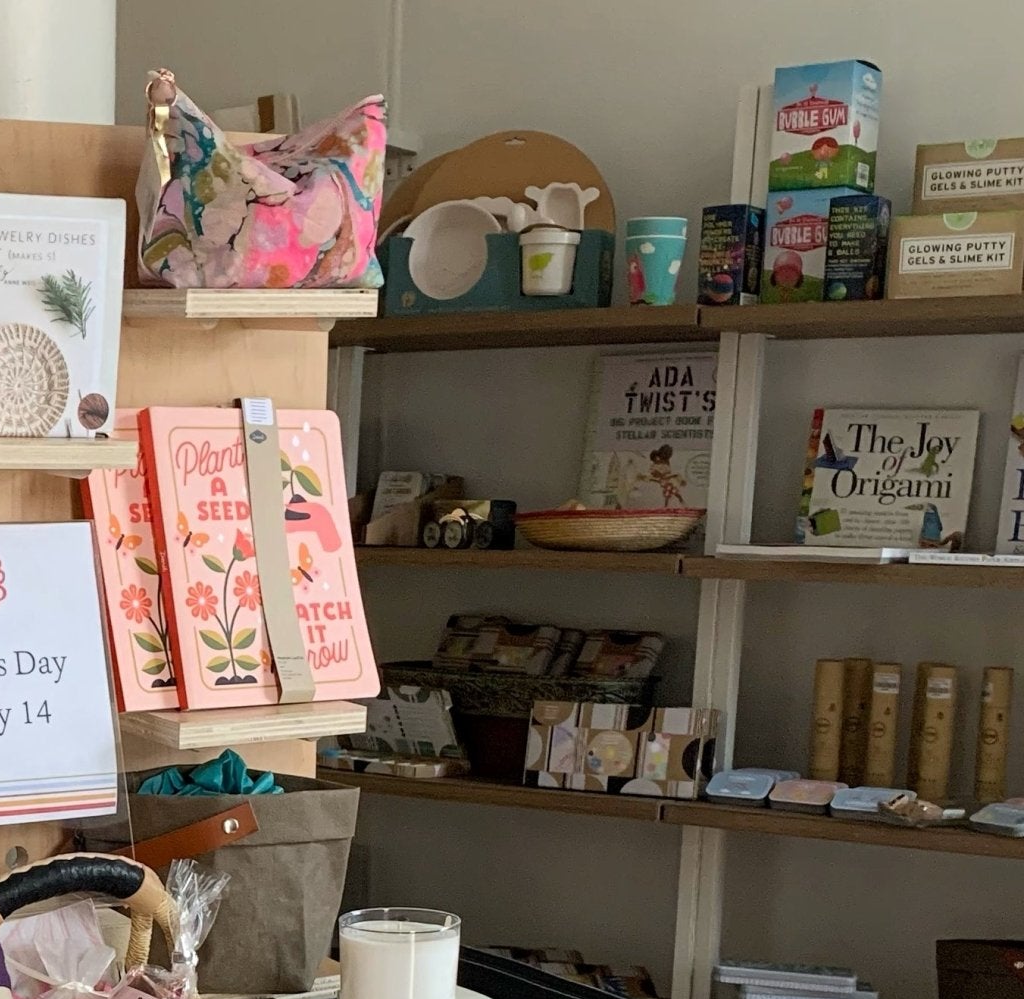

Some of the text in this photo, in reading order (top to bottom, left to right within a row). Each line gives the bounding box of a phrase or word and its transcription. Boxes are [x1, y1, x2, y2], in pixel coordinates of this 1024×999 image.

[779, 107, 846, 130] BUBBLE GUM
[931, 166, 1024, 181] GLOWING PUTTY
[930, 177, 1024, 192] GELS & SLIME KIT
[48, 232, 96, 246] DISHES
[772, 226, 812, 245] BUBBLE
[908, 241, 1006, 254] GLOWING PUTTY
[907, 252, 1006, 265] GELS & SLIME KIT
[648, 365, 694, 388] ADA
[625, 390, 716, 413] TWIST'S
[628, 417, 671, 426] PROJECT
[676, 416, 701, 425] BOOK
[616, 430, 656, 440] STELLAR
[847, 422, 961, 464] The Joy
[176, 436, 245, 486] Plant
[882, 447, 911, 478] of
[211, 477, 228, 496] A
[831, 468, 953, 506] Origami
[197, 500, 251, 521] SEED
[296, 602, 353, 621] ATCH
[307, 626, 326, 643] IT
[307, 638, 349, 670] row
[14, 650, 68, 684] Day
[22, 699, 52, 725] 14
